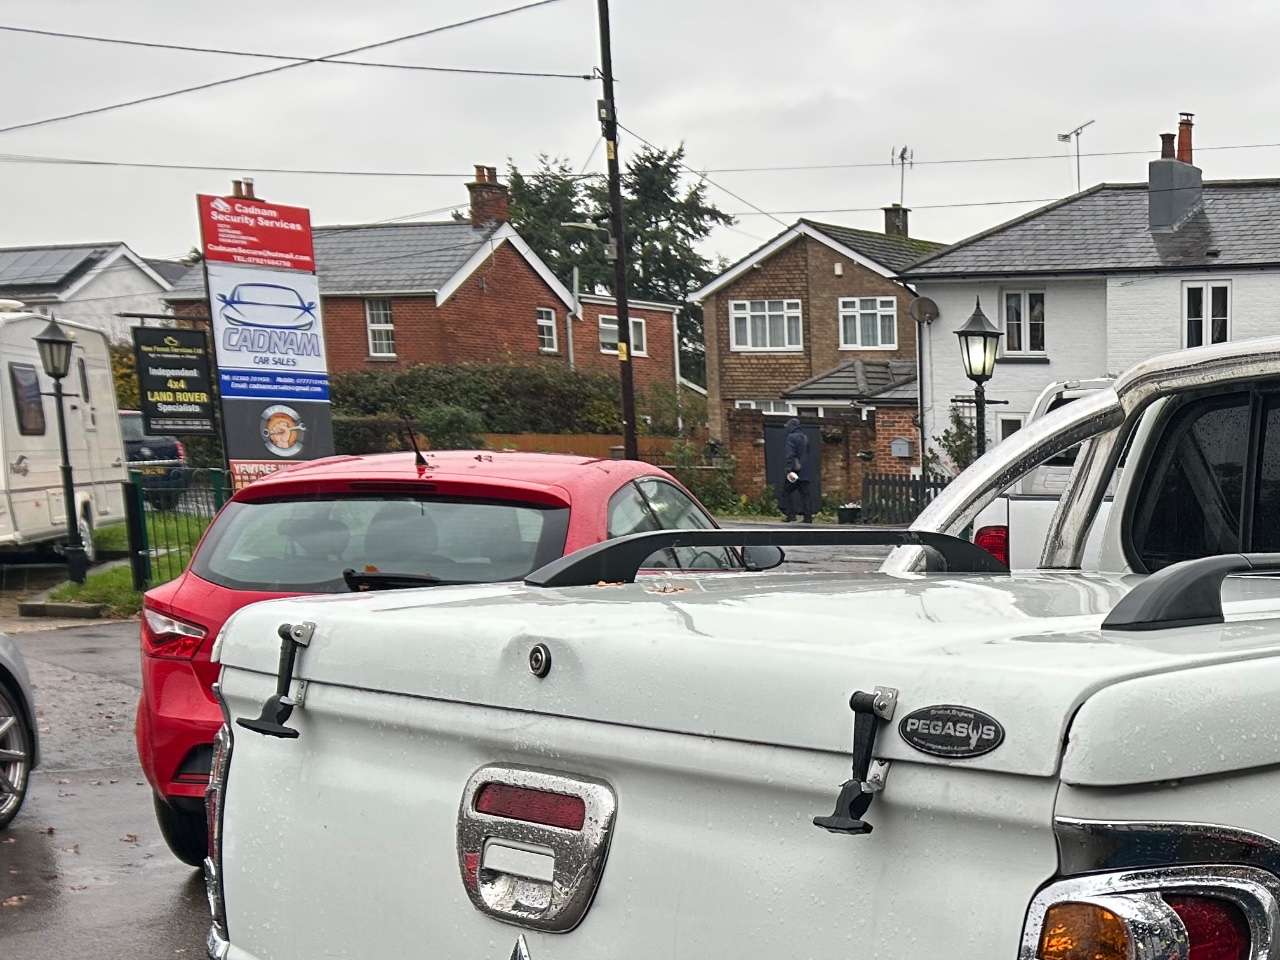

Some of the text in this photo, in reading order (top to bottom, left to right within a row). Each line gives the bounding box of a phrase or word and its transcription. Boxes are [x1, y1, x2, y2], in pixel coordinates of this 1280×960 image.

[234, 203, 277, 217] Cadnam
[210, 210, 302, 231] Security Services
[223, 326, 320, 357] CADNAM
[253, 355, 297, 367] CAR SALES
[148, 366, 199, 377] Independent
[167, 379, 186, 389] 4x4
[147, 391, 208, 403] LAND ROVER
[157, 402, 201, 413] Specialists
